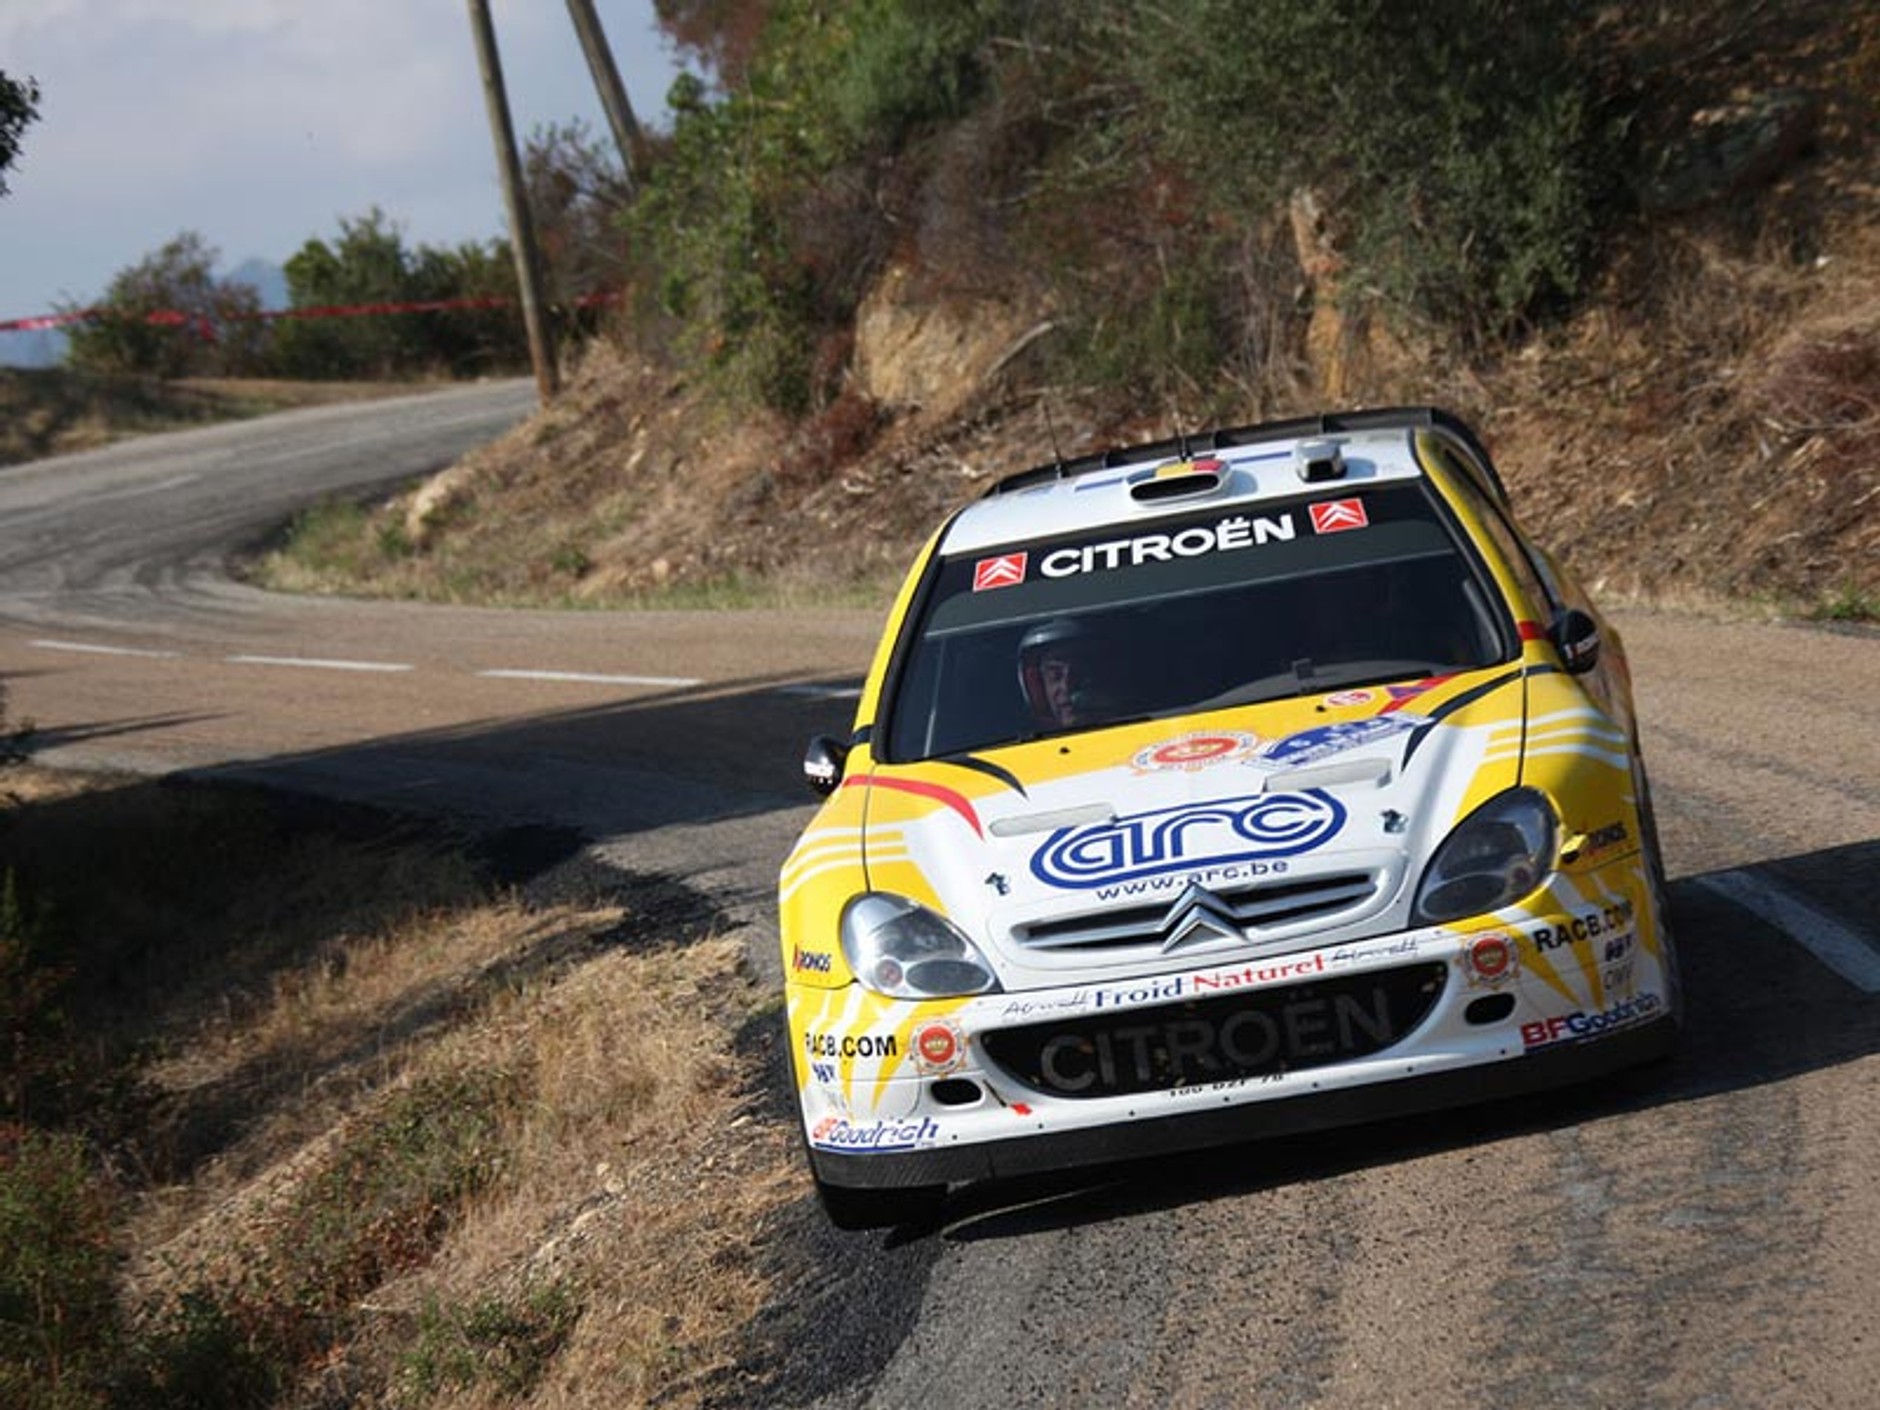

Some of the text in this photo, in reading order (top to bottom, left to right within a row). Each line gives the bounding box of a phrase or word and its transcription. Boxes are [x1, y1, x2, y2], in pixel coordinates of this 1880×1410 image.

[1040, 512, 1296, 579] CITROËN
[1030, 787, 1348, 890] arc
[1096, 860, 1289, 901] www.arc.be
[1095, 977, 1182, 1007] Froid
[1040, 987, 1394, 1091] CITROËN
